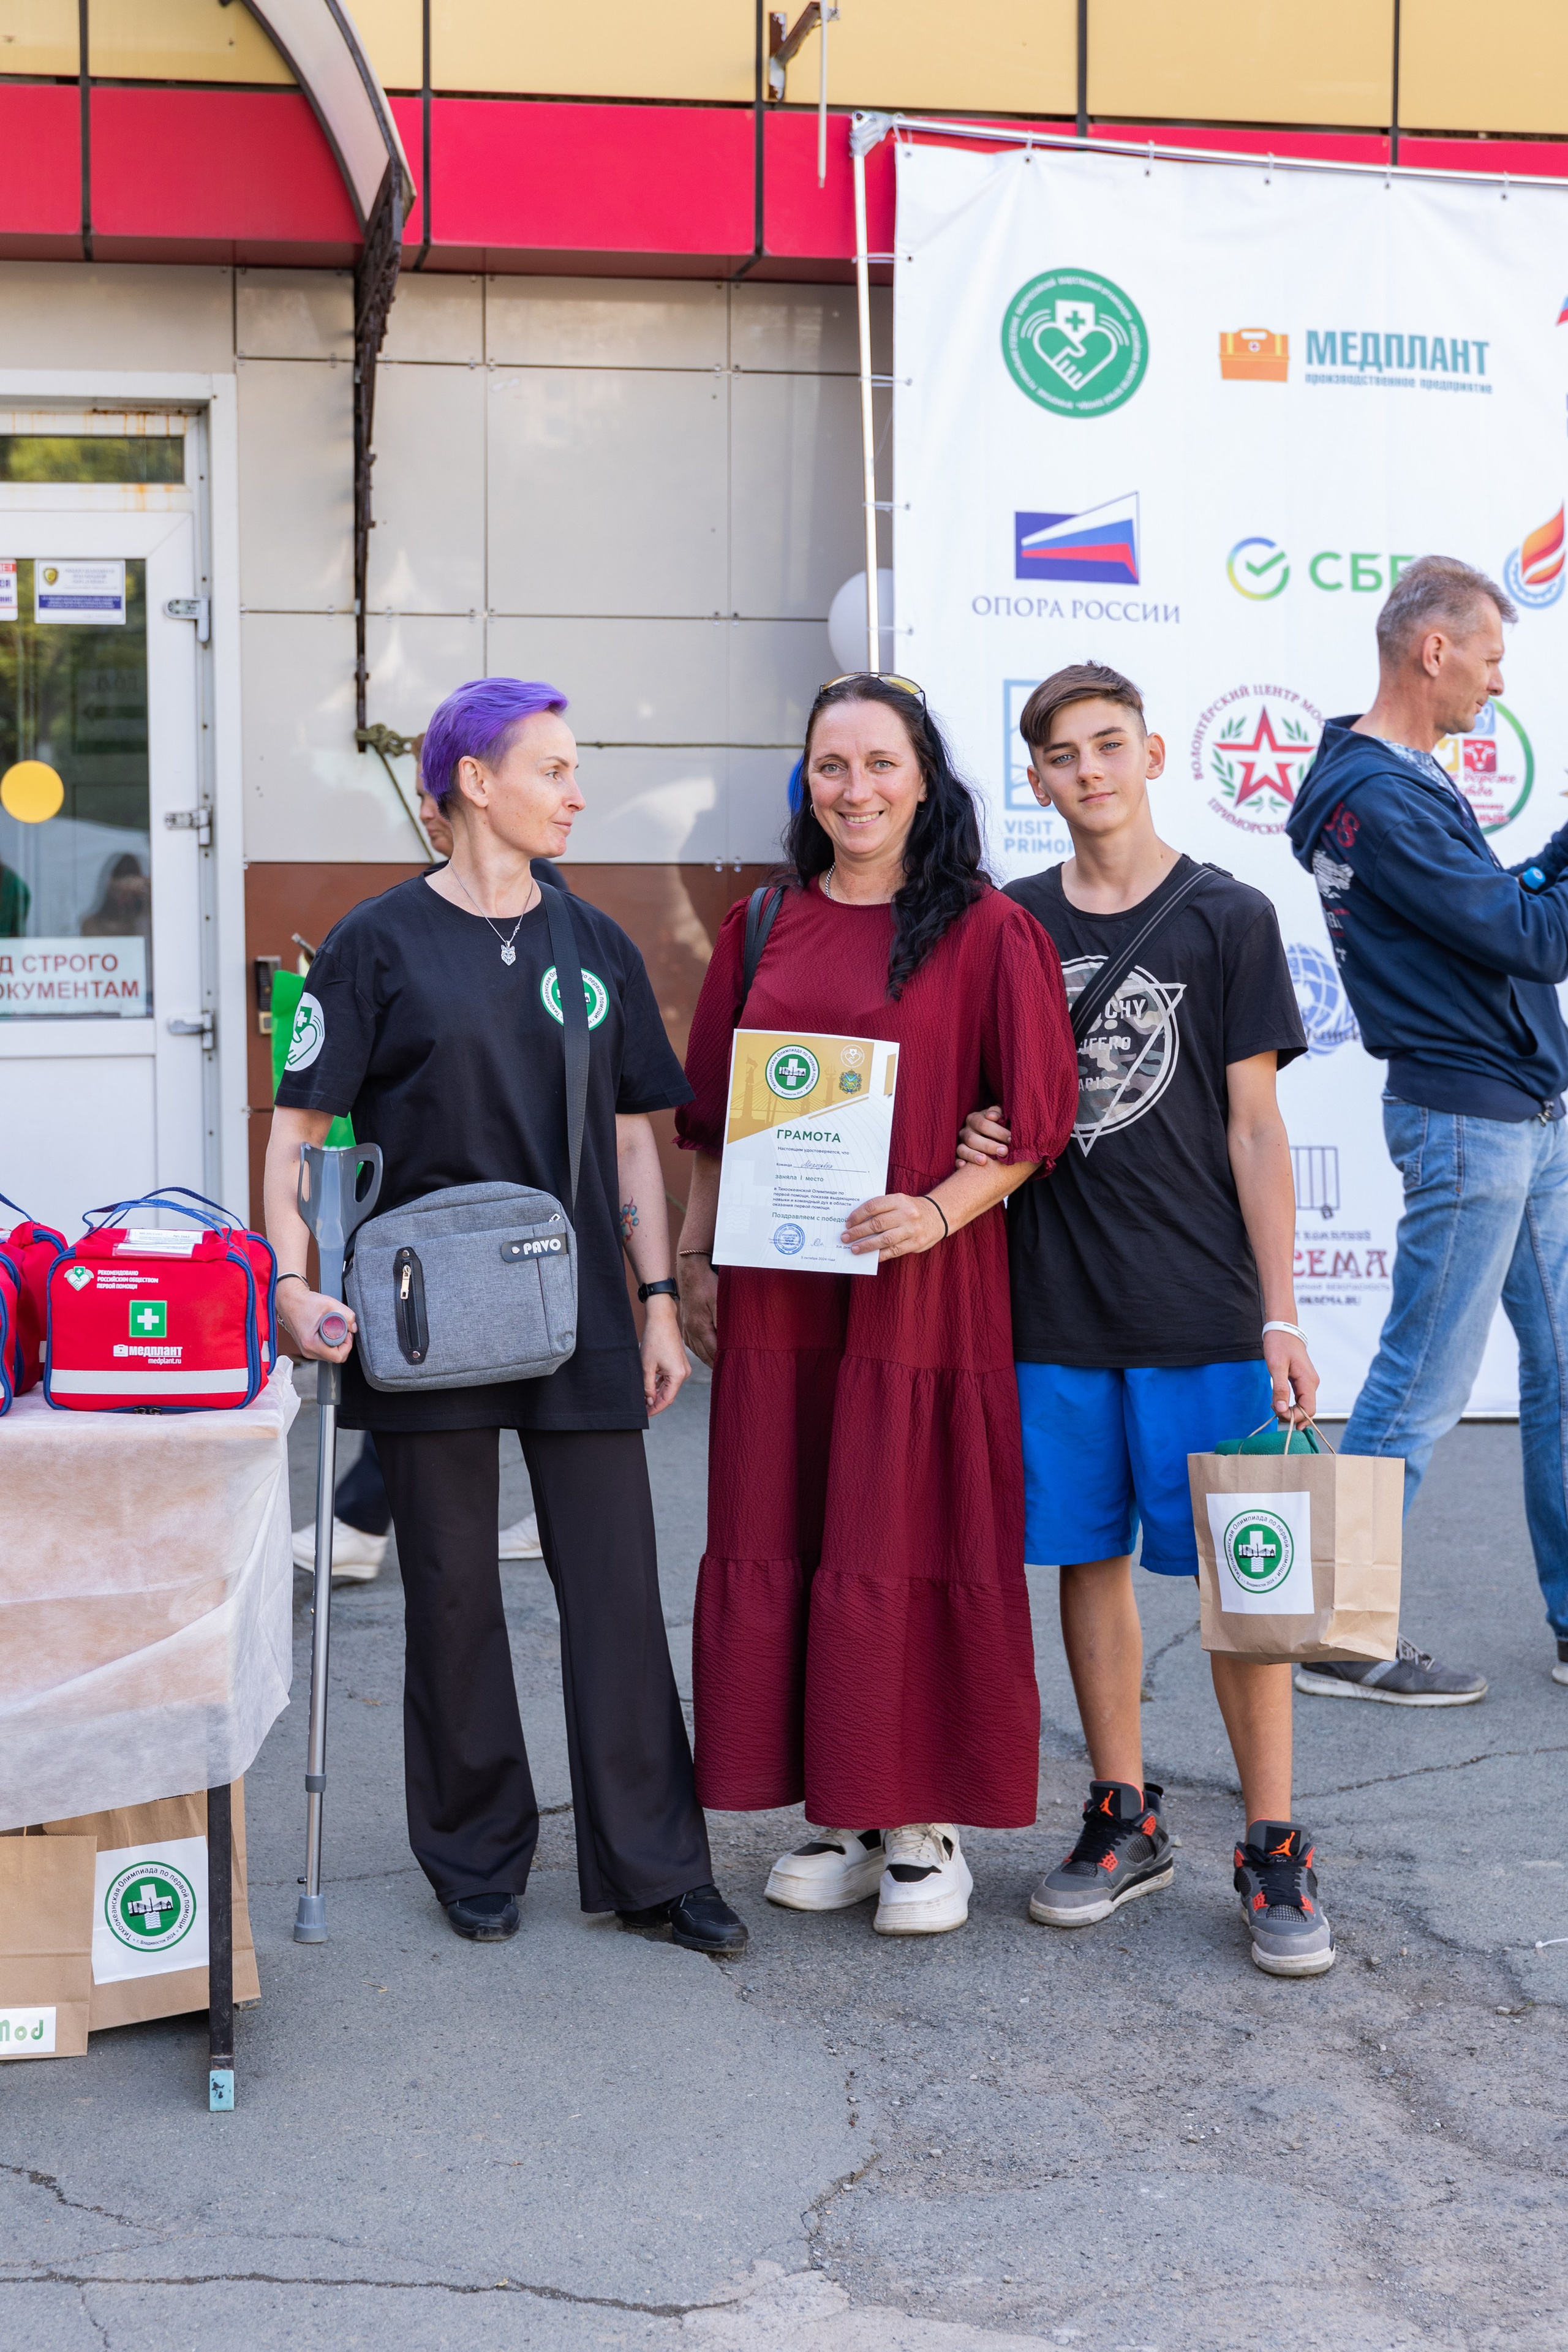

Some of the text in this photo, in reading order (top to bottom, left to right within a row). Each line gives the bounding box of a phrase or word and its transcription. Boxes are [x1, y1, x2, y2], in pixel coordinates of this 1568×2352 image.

[1306, 330, 1490, 375] МЕДПЛАНТ
[1305, 372, 1493, 394] производственное предприятие
[971, 595, 1180, 624] ОПОРА РОССИИ
[1254, 684, 1300, 703] ЦЕНТР
[1207, 797, 1286, 835] ПРИМОРСКИ
[1005, 820, 1053, 835] VISIT
[22, 954, 118, 973] СТРОГО
[588, 978, 603, 995] первой
[594, 997, 604, 1019] помощи
[777, 1048, 802, 1057] Олимпиада
[777, 1129, 841, 1143] ГРАМОТА
[772, 1212, 815, 1221] Поздравляем
[523, 1238, 562, 1255] PAVO
[1233, 1515, 1268, 1530] Олимпиада
[1276, 1525, 1290, 1548] первой
[1227, 1530, 1240, 1580] Тихоокеанская
[1277, 1550, 1289, 1577] помощи
[118, 1868, 158, 1887] Олимпиада
[170, 1874, 189, 1898] первой
[111, 1888, 132, 1941] Тихоокеанская
[178, 1899, 190, 1929] помощи
[167, 1932, 176, 1940] 2024
